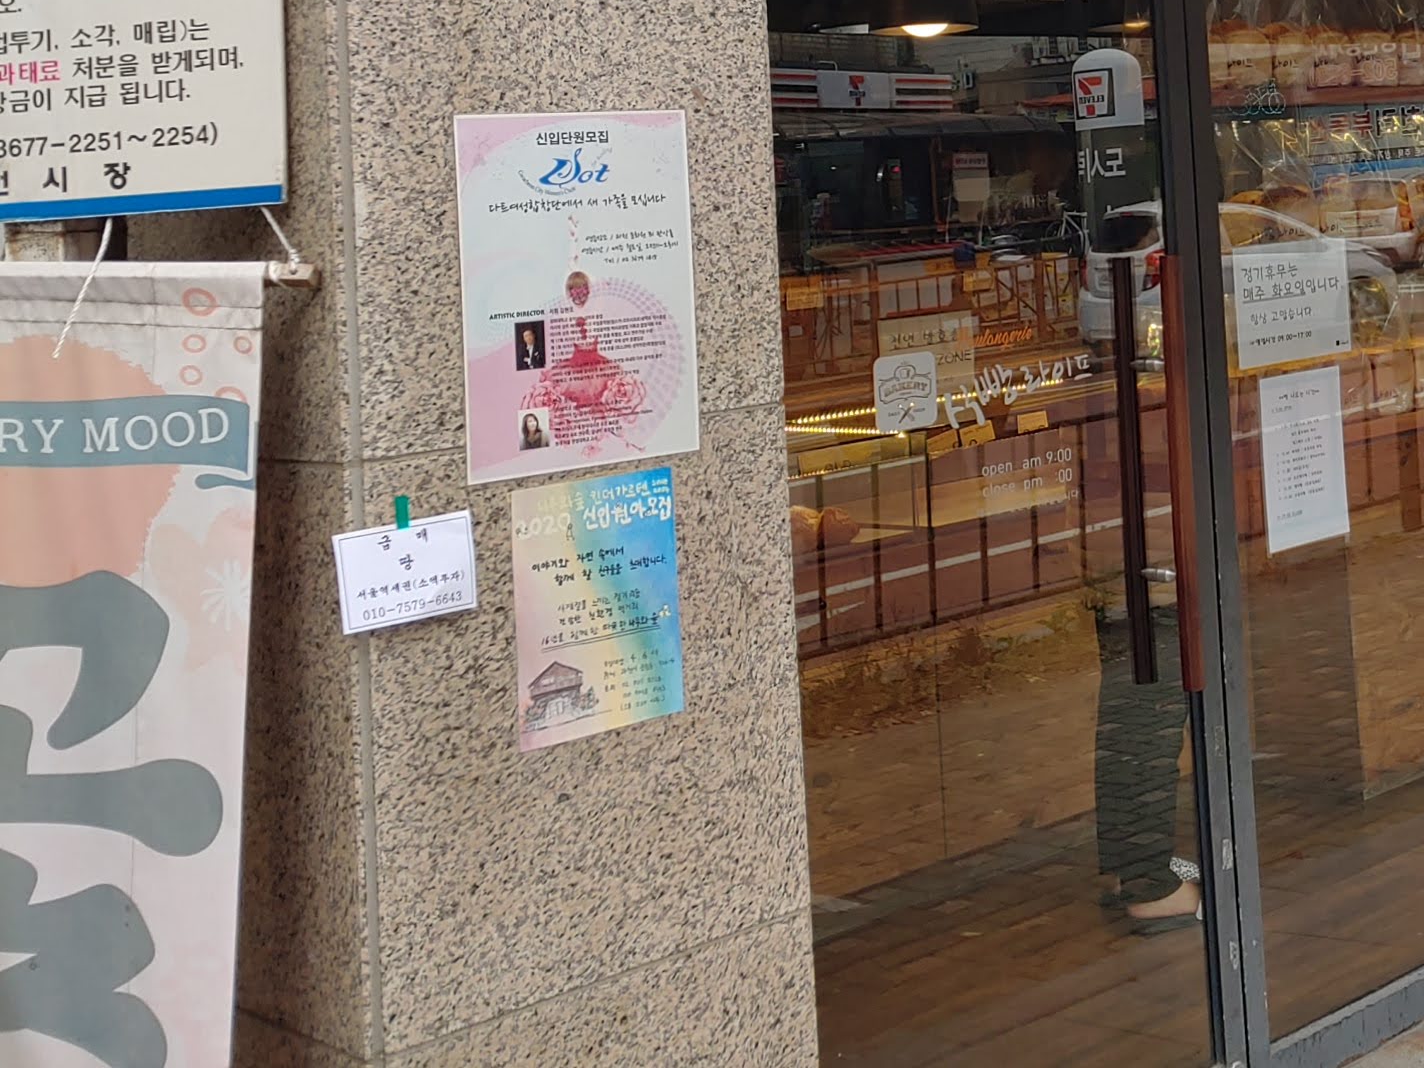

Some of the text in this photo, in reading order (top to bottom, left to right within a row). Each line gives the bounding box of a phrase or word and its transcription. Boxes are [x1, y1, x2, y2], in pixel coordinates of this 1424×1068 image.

[70, 24, 120, 48] 소각,
[133, 19, 210, 44] 매립)는
[0, 46, 244, 85] 과태료 처분을 받게되며,
[64, 85, 107, 108] 지급
[120, 79, 191, 105] 됩니다.
[536, 130, 609, 145] 신입단원모집
[631, 193, 666, 206] 모십니다
[1241, 262, 1298, 283] 정기휴무는
[1243, 286, 1265, 301] 매주
[489, 309, 545, 320] ARTISTIC DIRECTOR
[1271, 306, 1312, 322] 고맙습니다
[937, 351, 972, 366] ZONE
[82, 407, 230, 453] MOOD
[982, 448, 1072, 477] open am 9:00
[983, 481, 1015, 498] close
[1024, 477, 1043, 491] pm
[363, 591, 463, 621] 010-7579-6643
